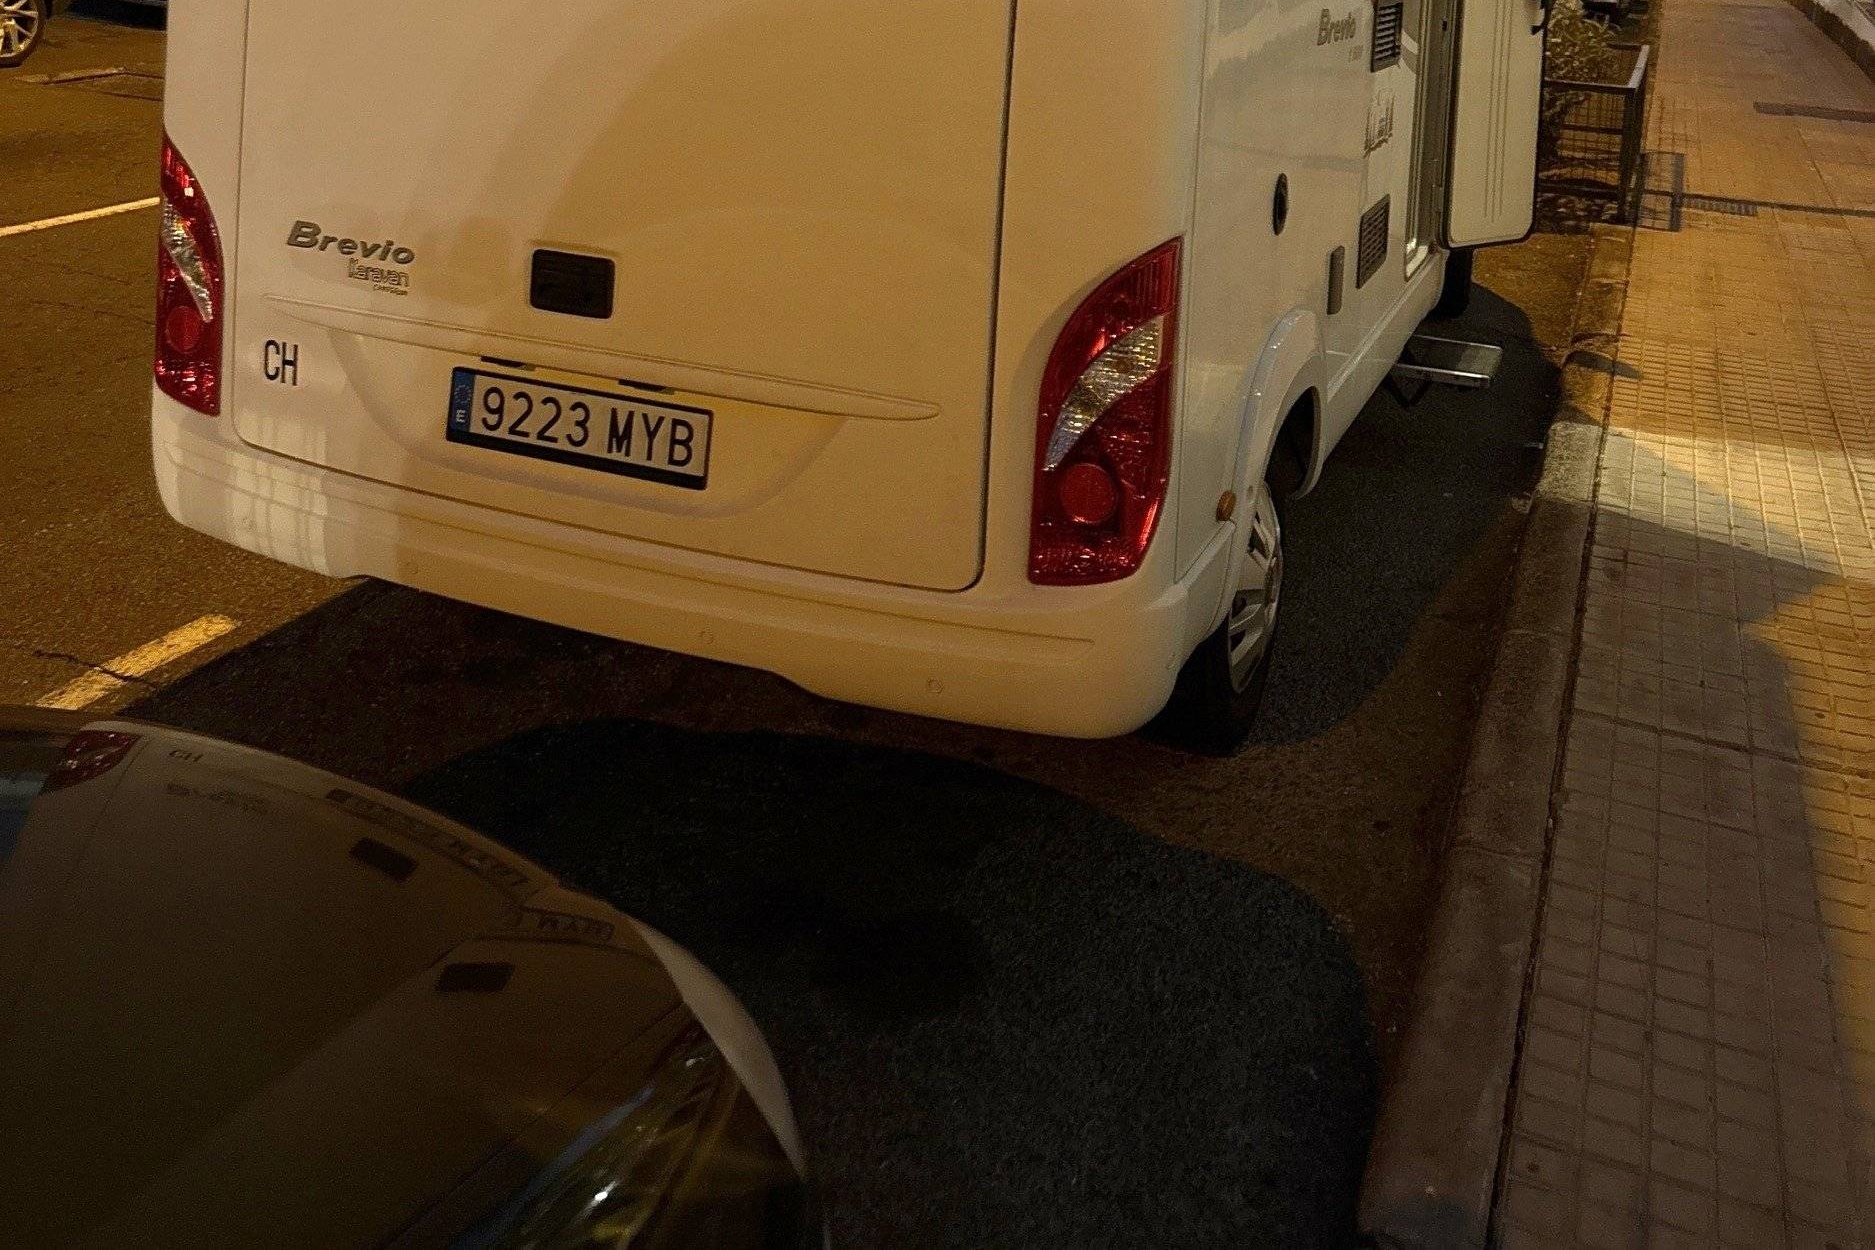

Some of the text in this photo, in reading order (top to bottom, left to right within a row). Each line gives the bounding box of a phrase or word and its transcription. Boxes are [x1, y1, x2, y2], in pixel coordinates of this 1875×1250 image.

[287, 220, 415, 264] Brevio
[264, 339, 299, 386] CH
[455, 386, 694, 467] E 9223 MYB
